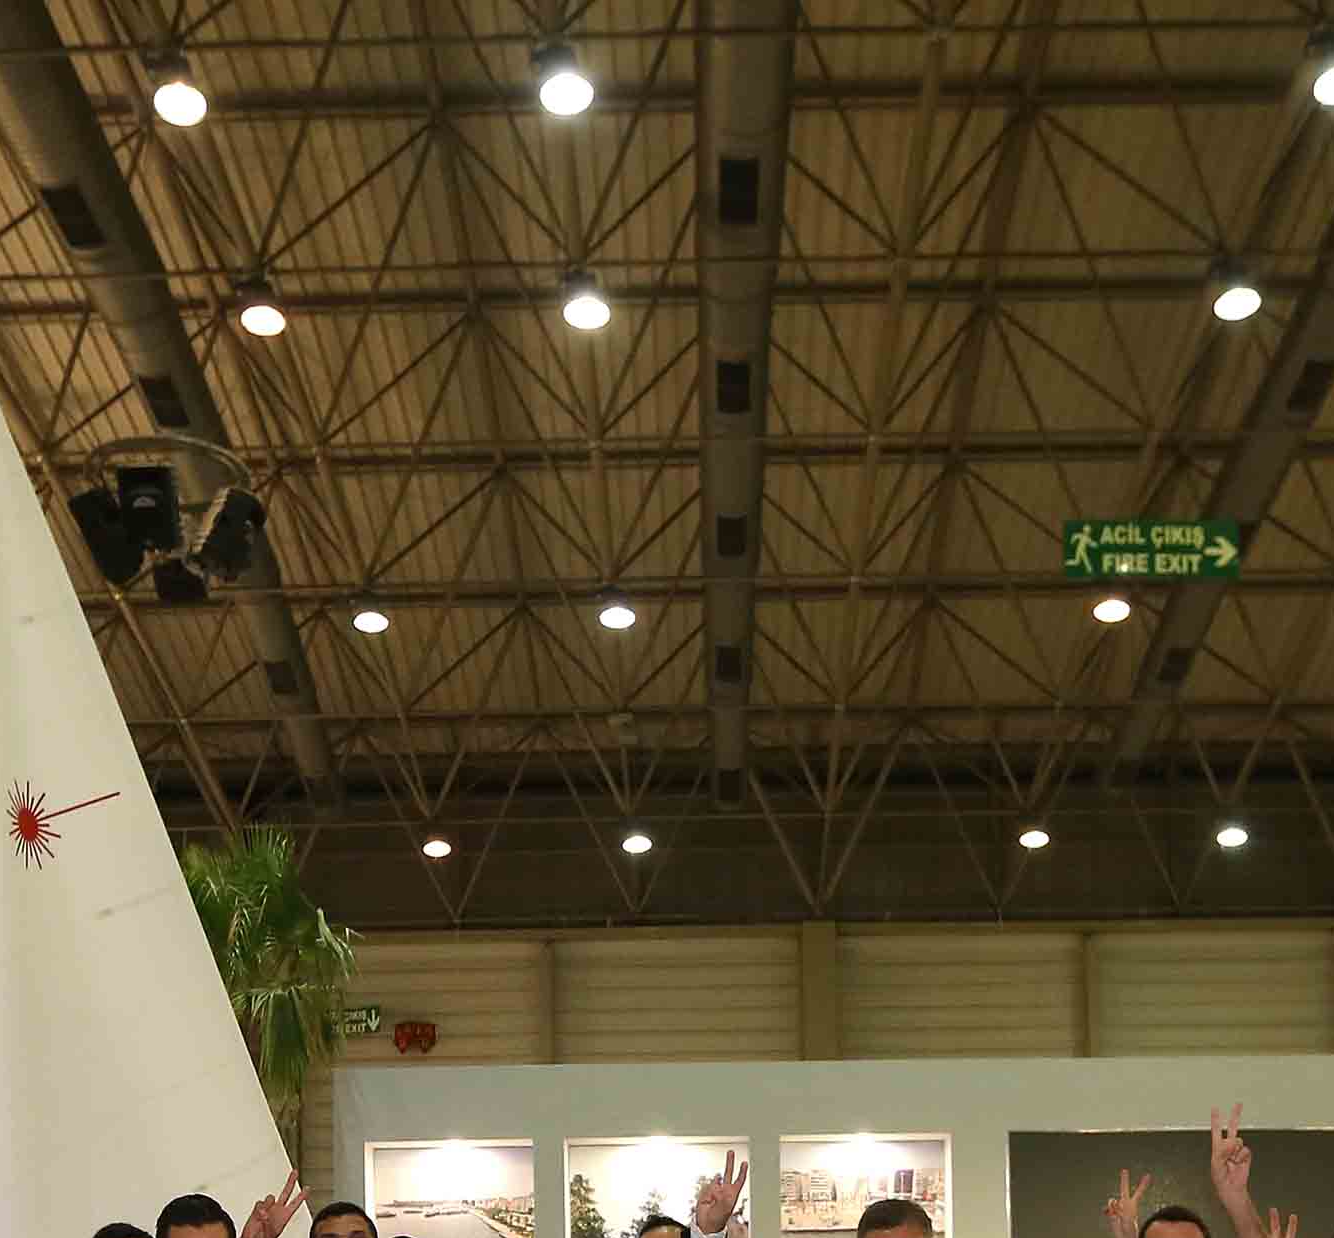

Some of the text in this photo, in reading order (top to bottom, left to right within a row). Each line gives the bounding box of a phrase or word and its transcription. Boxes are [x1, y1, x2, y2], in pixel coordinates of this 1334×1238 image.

[1100, 521, 1205, 549] ACİL ÇIKIŞ
[1101, 553, 1201, 573] FIRE EXIT
